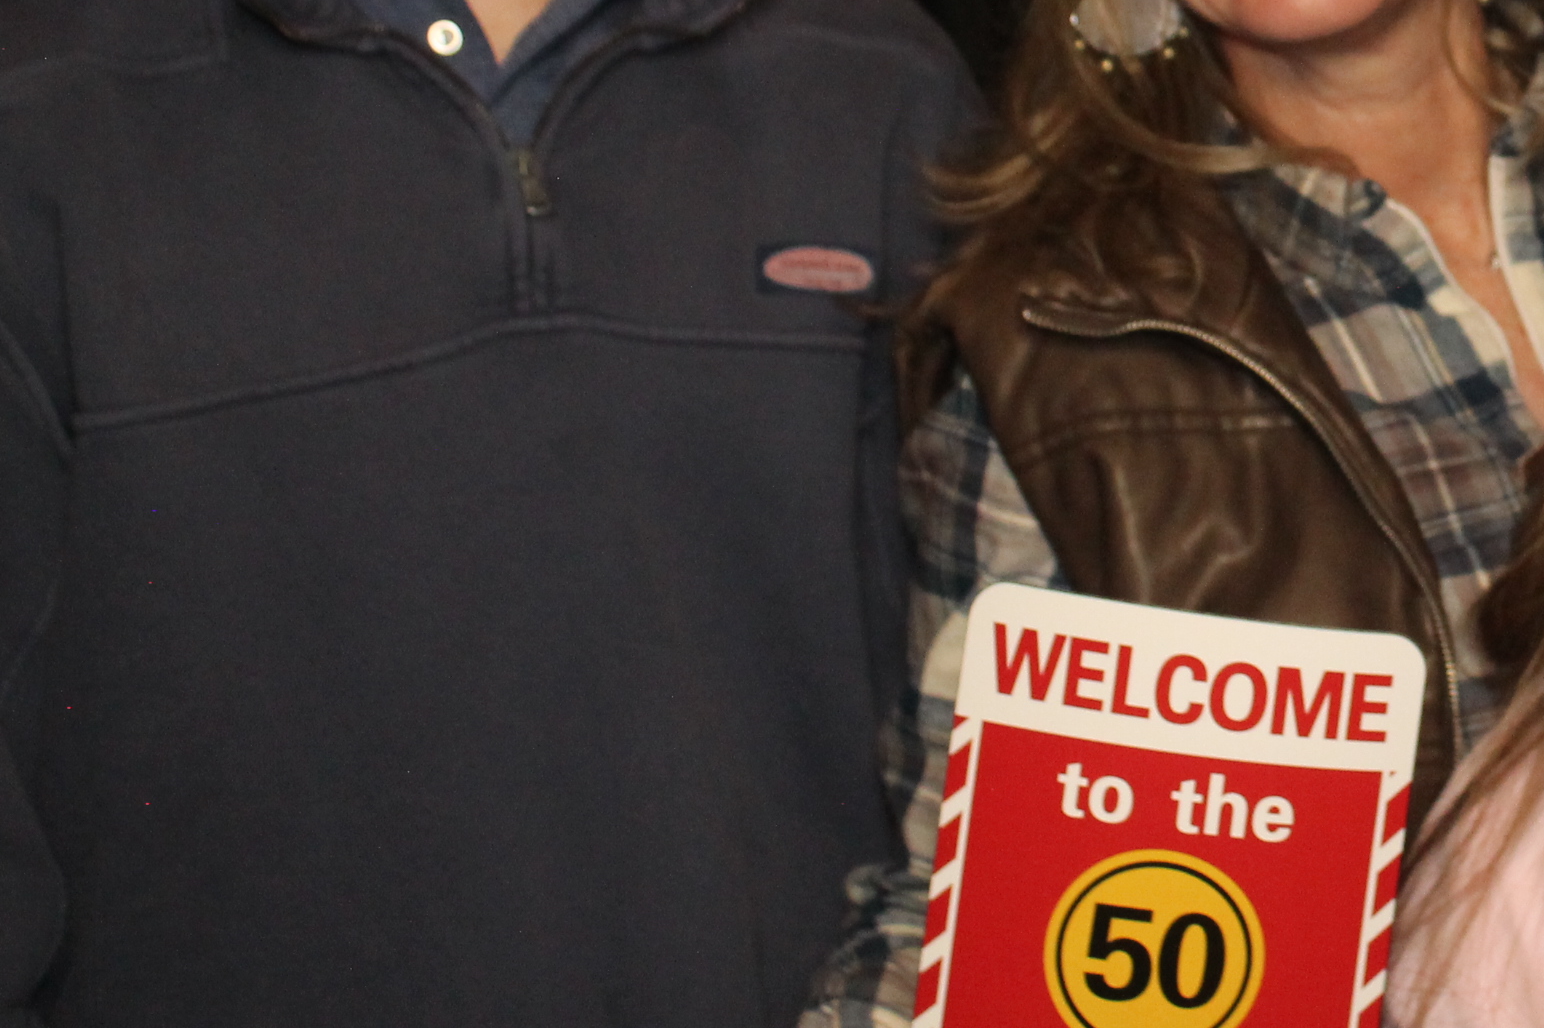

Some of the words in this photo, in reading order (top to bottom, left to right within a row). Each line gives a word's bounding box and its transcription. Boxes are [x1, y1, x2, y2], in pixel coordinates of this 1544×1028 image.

[993, 621, 1394, 743] WELCOME
[1056, 762, 1134, 824] to
[1170, 772, 1295, 843] the
[1083, 902, 1227, 1010] 50
